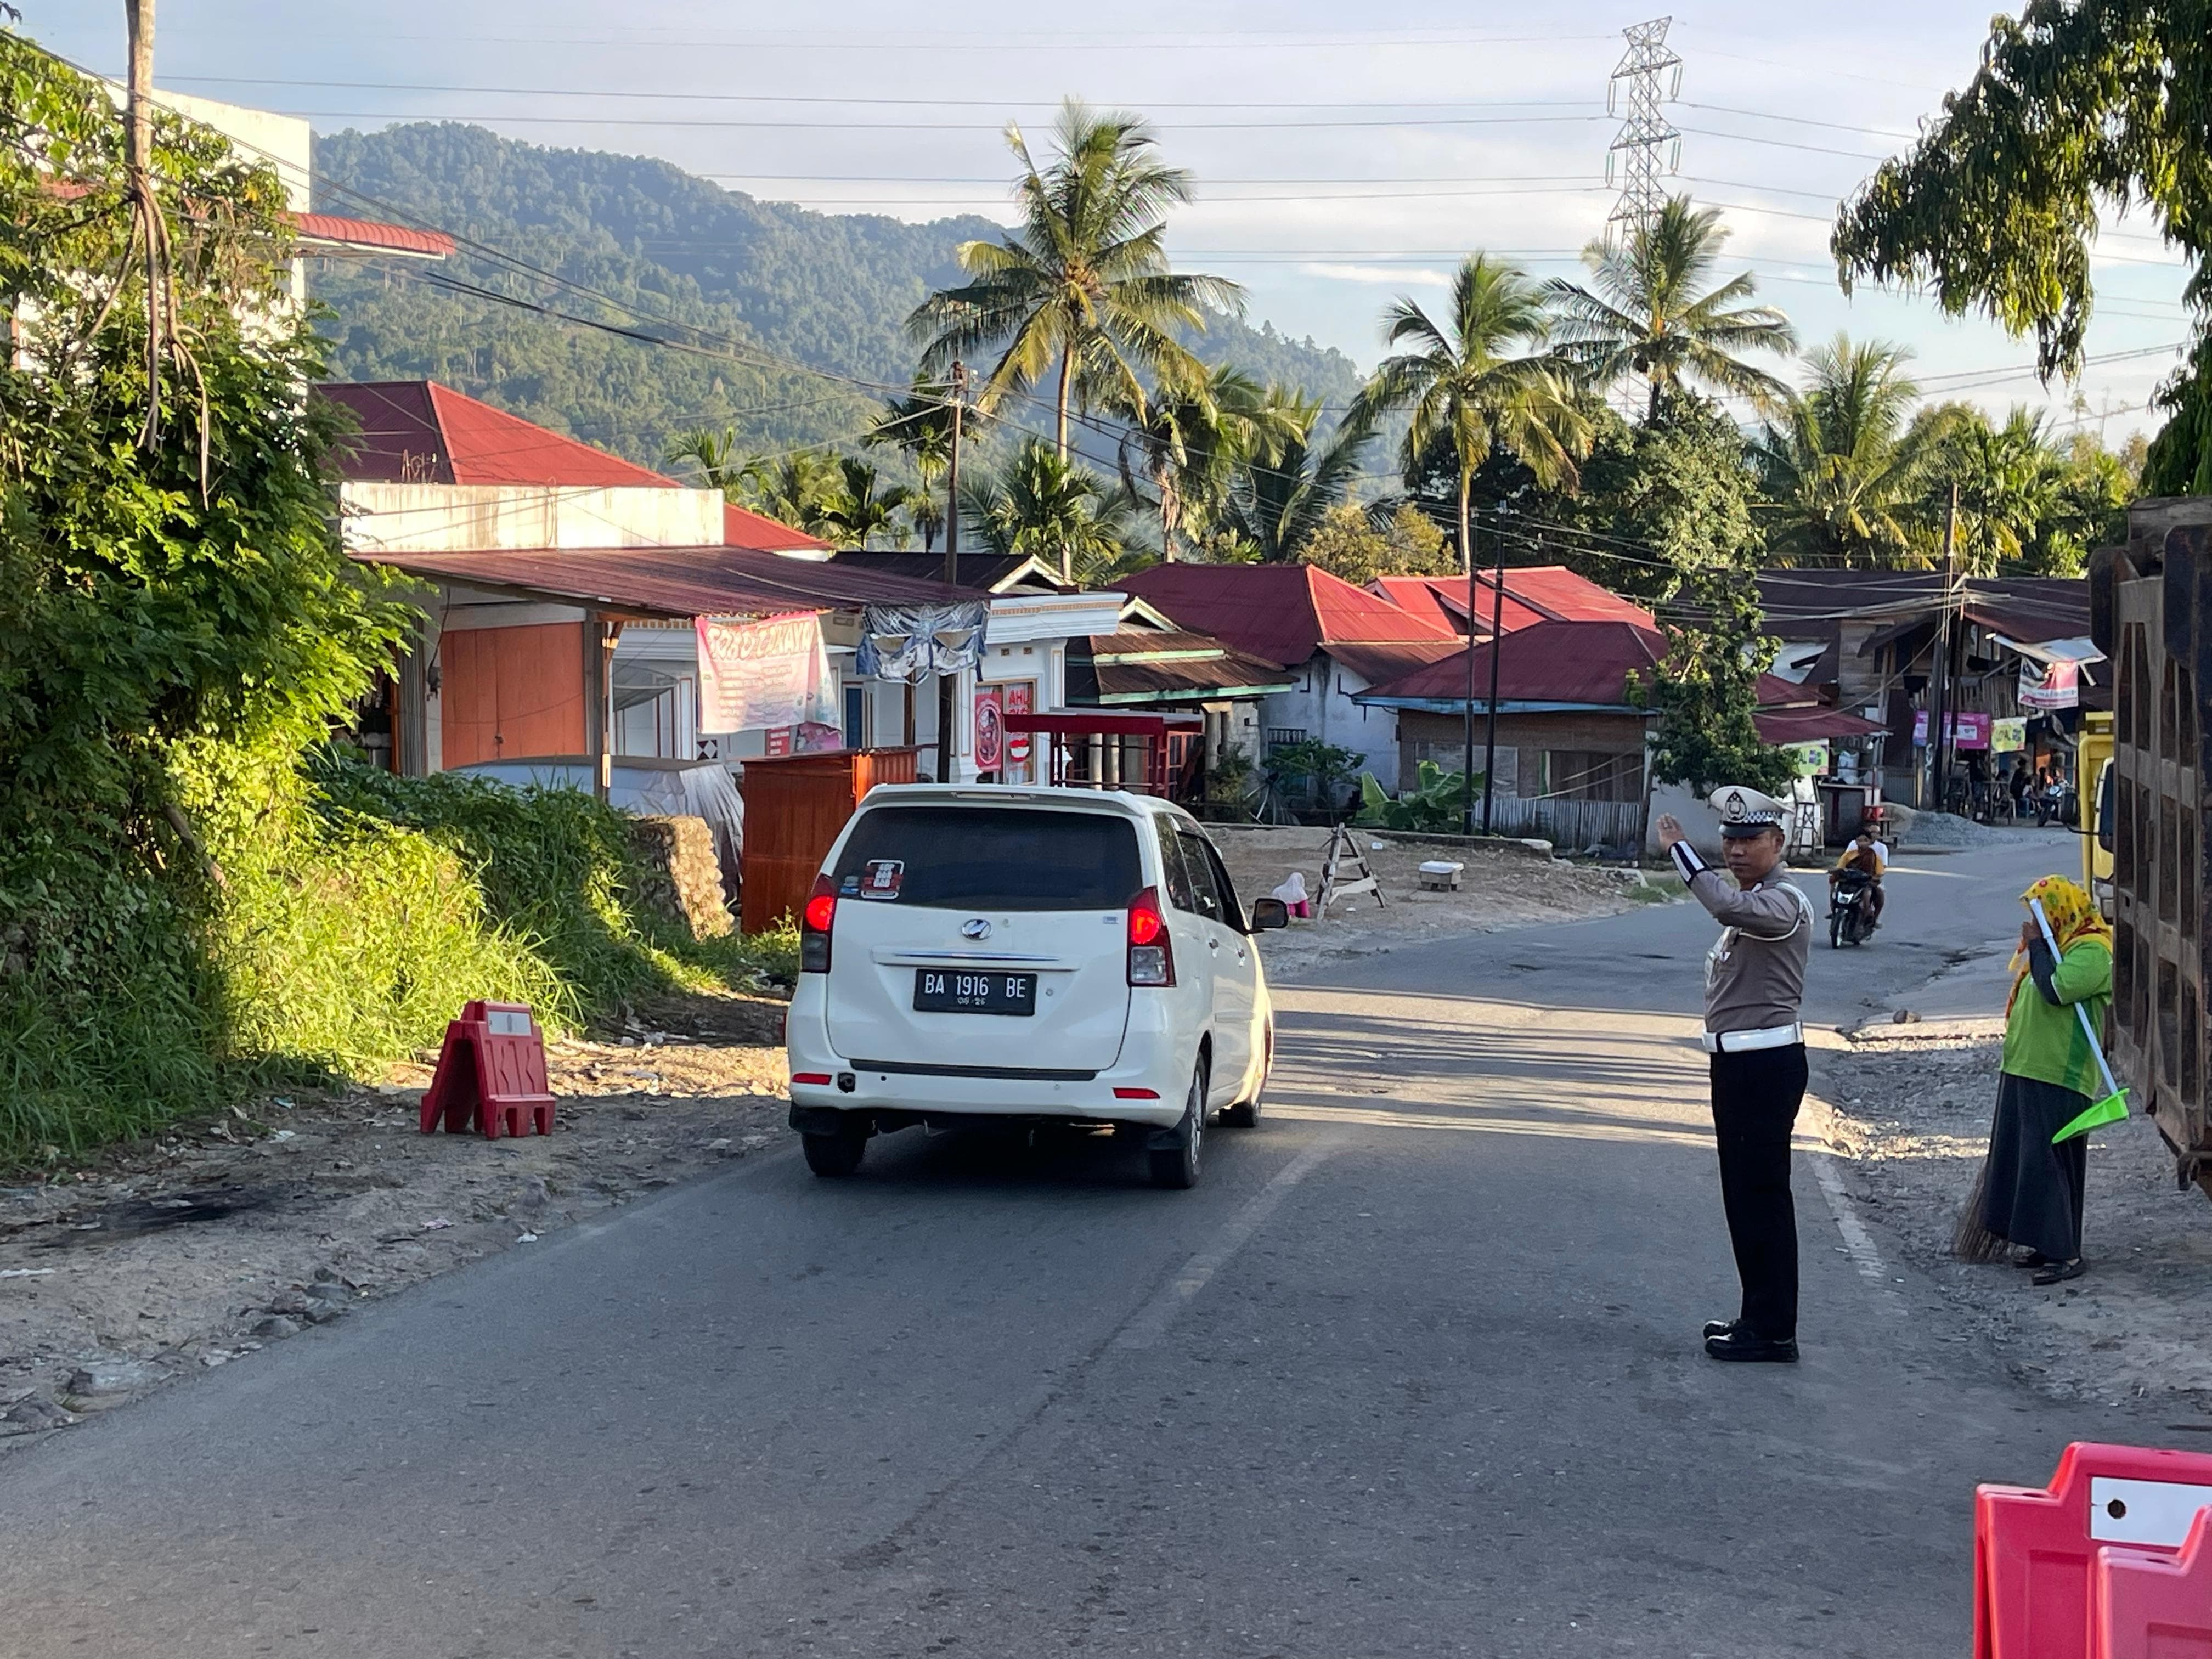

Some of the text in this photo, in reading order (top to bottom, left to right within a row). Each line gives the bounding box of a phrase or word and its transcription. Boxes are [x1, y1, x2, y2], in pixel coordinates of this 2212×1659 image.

[924, 974, 1027, 998] BA 1916 BE
